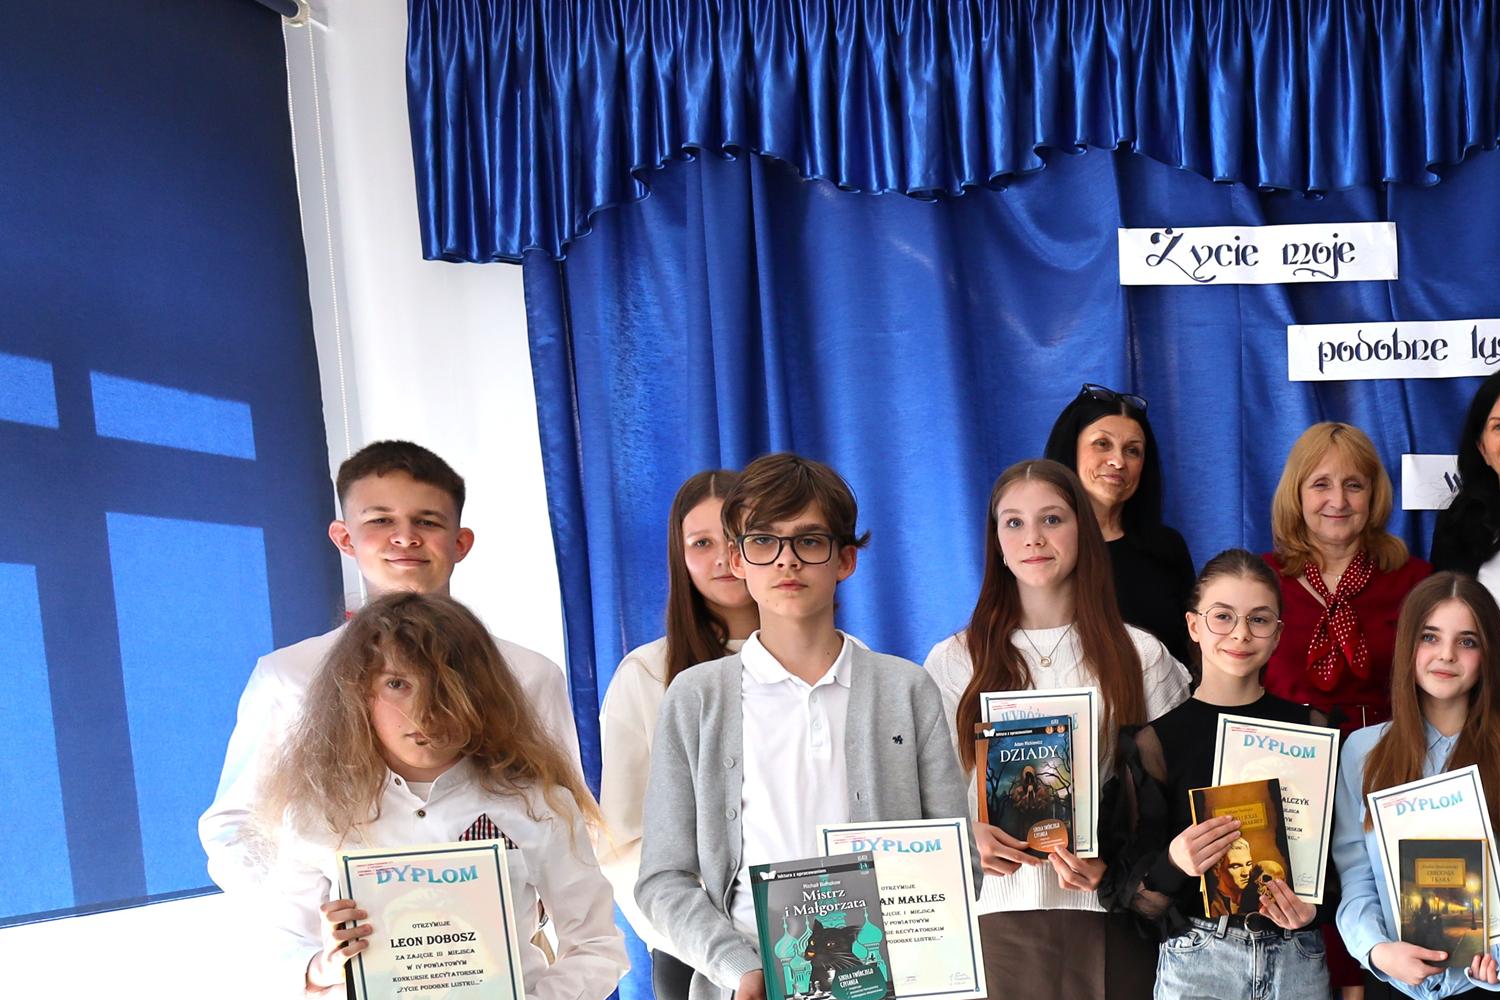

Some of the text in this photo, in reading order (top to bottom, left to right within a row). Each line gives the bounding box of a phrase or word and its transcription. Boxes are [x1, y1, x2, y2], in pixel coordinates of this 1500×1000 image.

[1146, 228, 1355, 283] Życie moje
[1318, 327, 1449, 374] podobne
[1000, 745, 1058, 763] DZIADY
[1244, 734, 1316, 758] DYPLOM
[1281, 796, 1310, 806] ALCZYK
[1396, 790, 1463, 816] DYPLOM
[852, 837, 943, 853] DYPLOM
[376, 864, 479, 885] DYPLOM
[803, 889, 845, 901] Mistrz
[880, 893, 946, 906] AN MAKLES
[784, 900, 866, 917] i Małgorzata
[412, 920, 451, 929] OTRZYMUJE
[889, 918, 930, 926] POWIATOWYM
[390, 932, 477, 948] LEON DOBOSZ
[448, 948, 475, 956] MIEJSCA
[424, 960, 467, 968] POWIATOWYM
[392, 969, 484, 982] KONKURSIE RECYTATORSKIM
